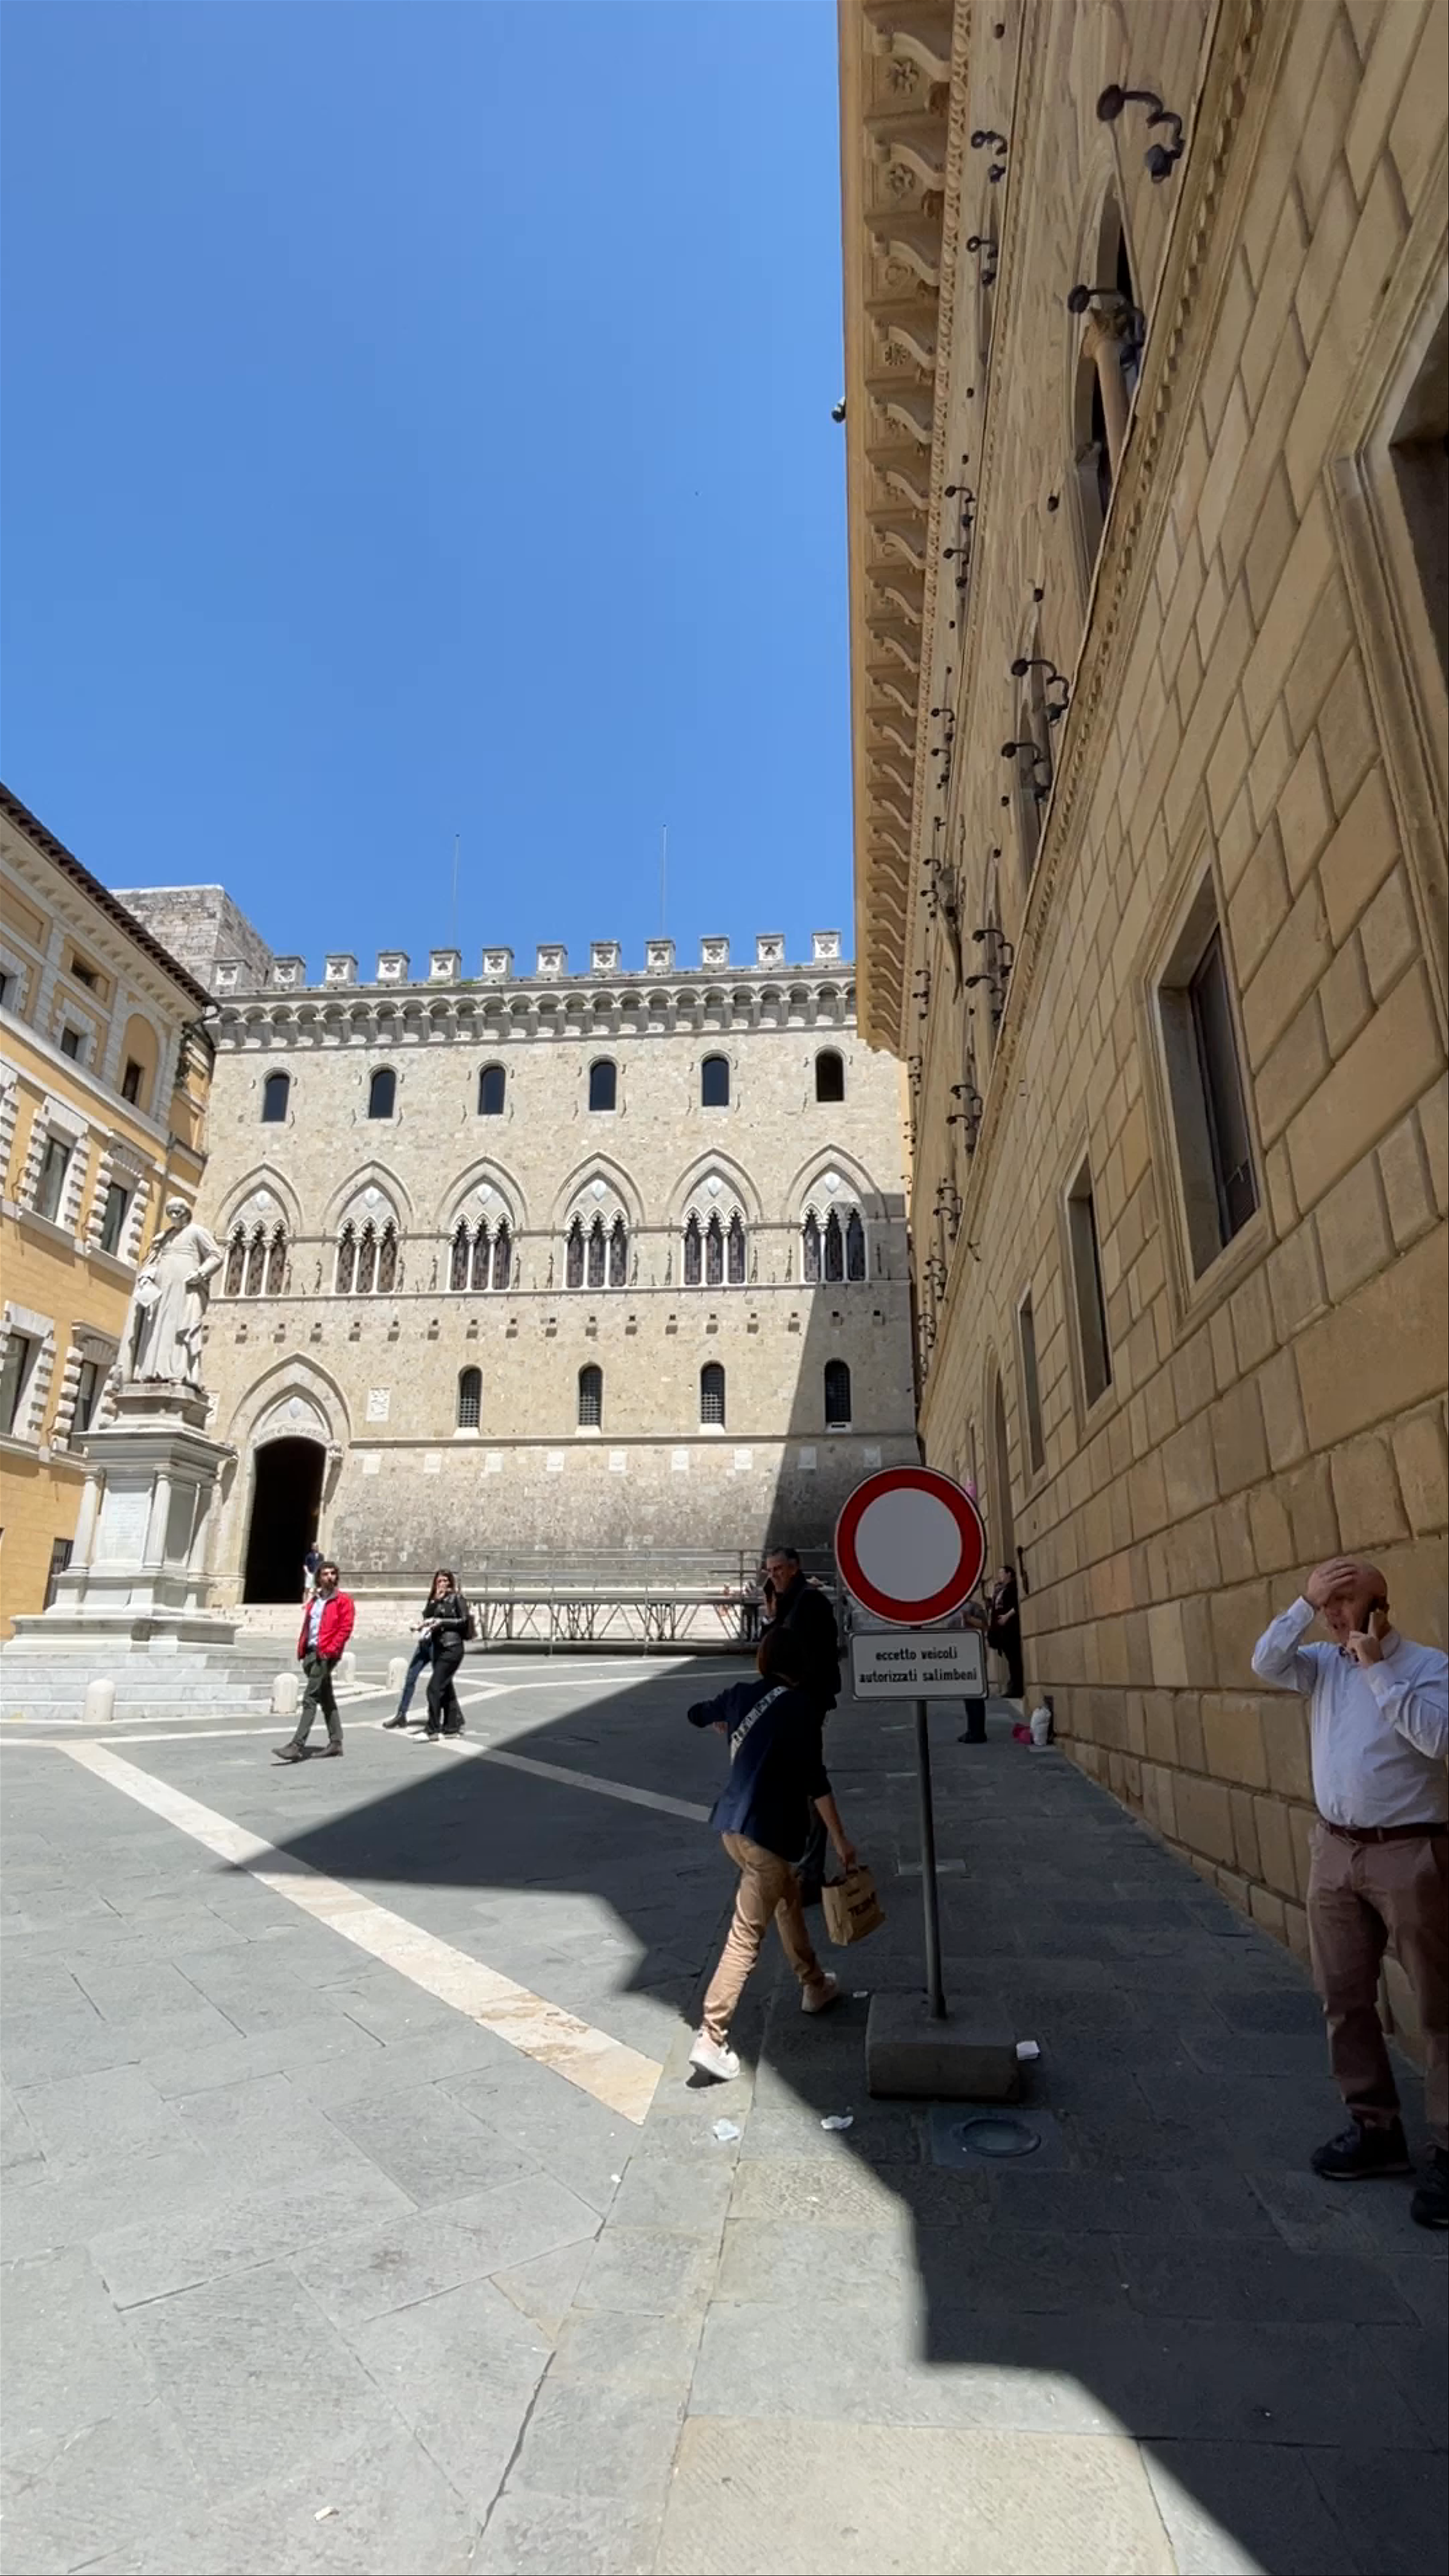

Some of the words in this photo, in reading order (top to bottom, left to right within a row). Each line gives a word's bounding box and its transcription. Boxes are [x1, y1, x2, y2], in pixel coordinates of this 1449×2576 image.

[875, 1648, 917, 1661] eccetto
[921, 1646, 957, 1659] veicoli
[859, 1668, 917, 1682] autorizzati
[923, 1667, 977, 1681] salimbeni
